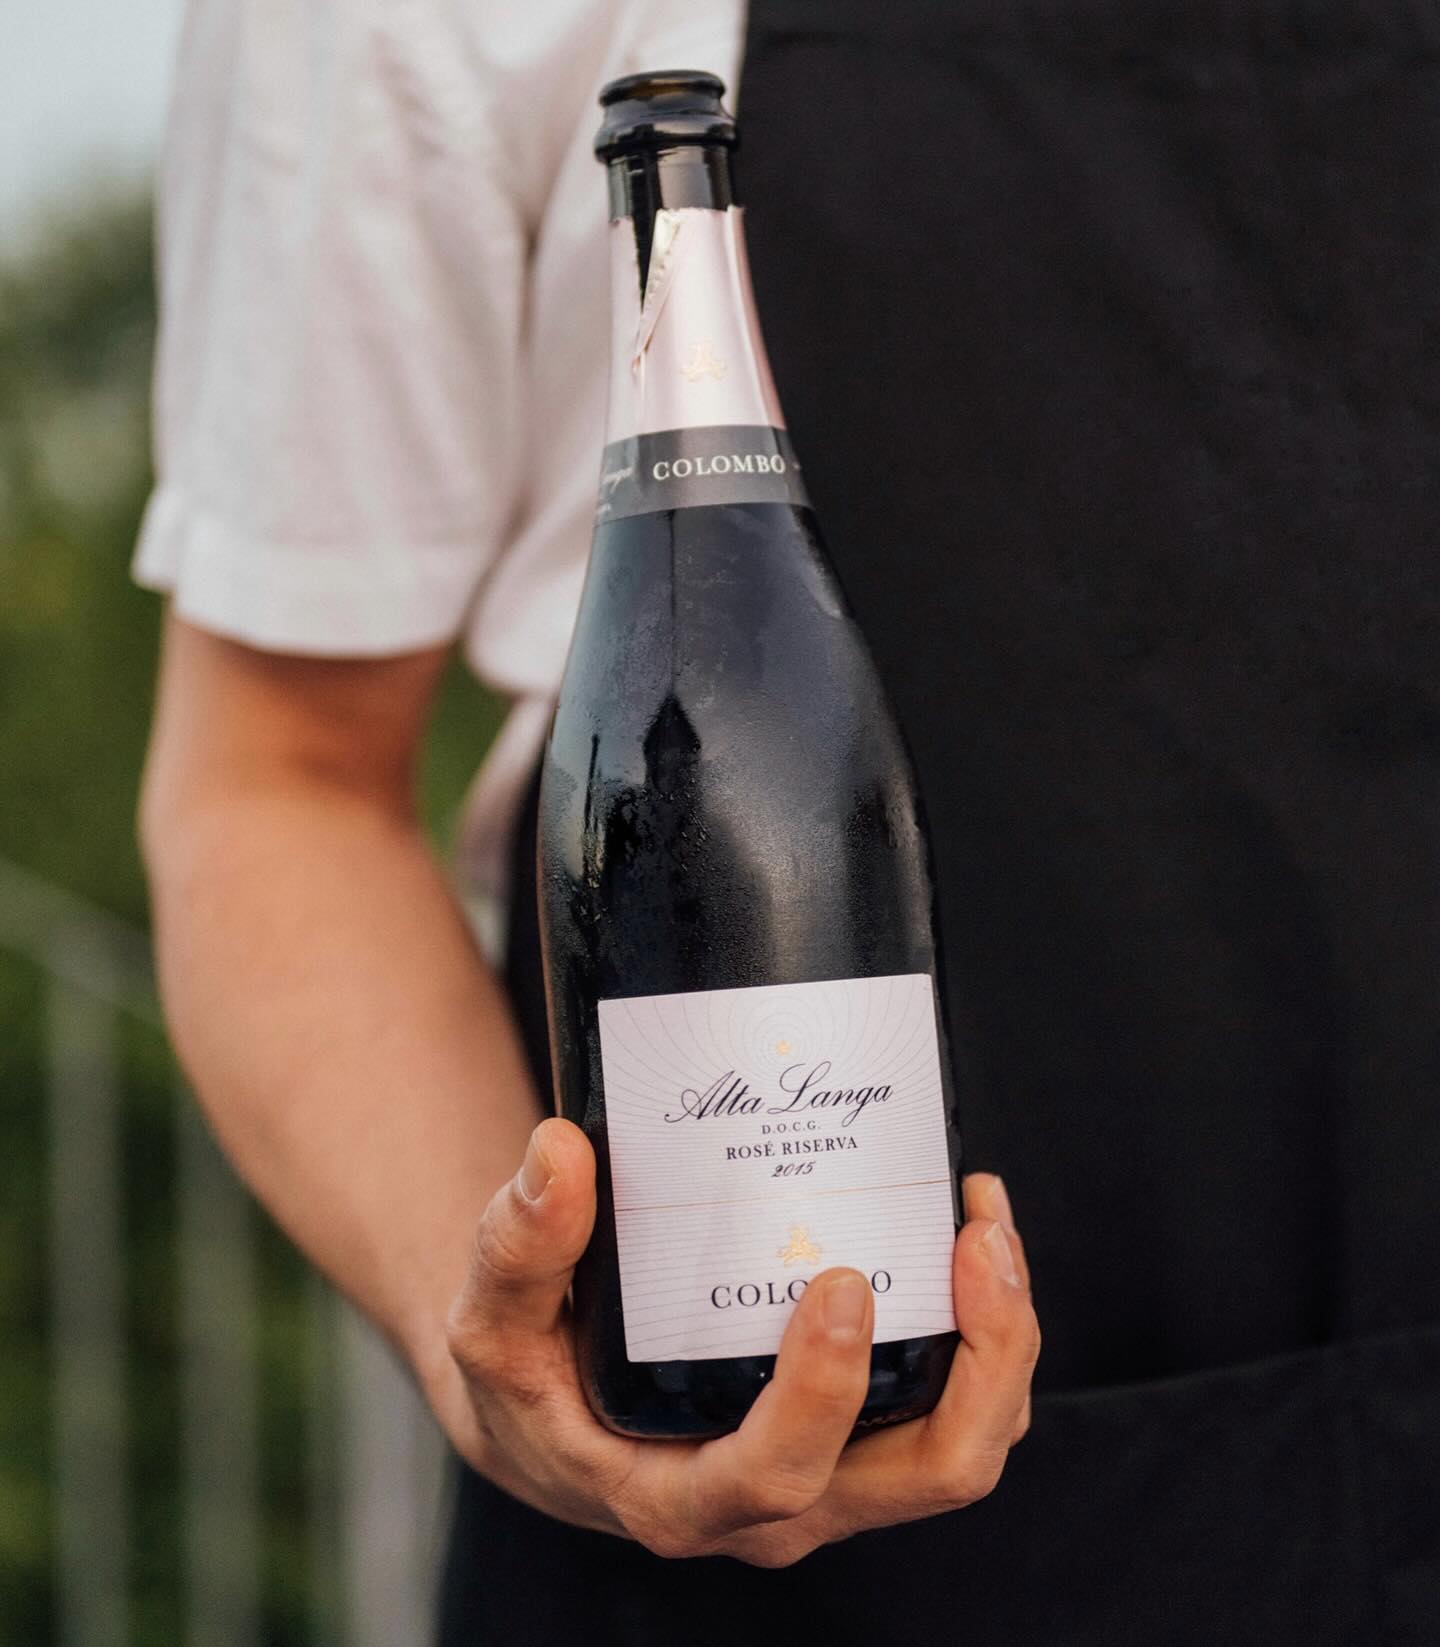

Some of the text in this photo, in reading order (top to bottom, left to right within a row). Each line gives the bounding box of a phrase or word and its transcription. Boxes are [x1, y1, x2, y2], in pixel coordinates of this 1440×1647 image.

[652, 455, 786, 480] COLOMBO
[664, 1061, 894, 1127] Alta Langa
[761, 1121, 822, 1135] D.O.C.G.
[727, 1137, 859, 1160] ROSÉ RISERVA
[771, 1161, 817, 1178] 2015
[710, 1270, 893, 1309] COLOO
